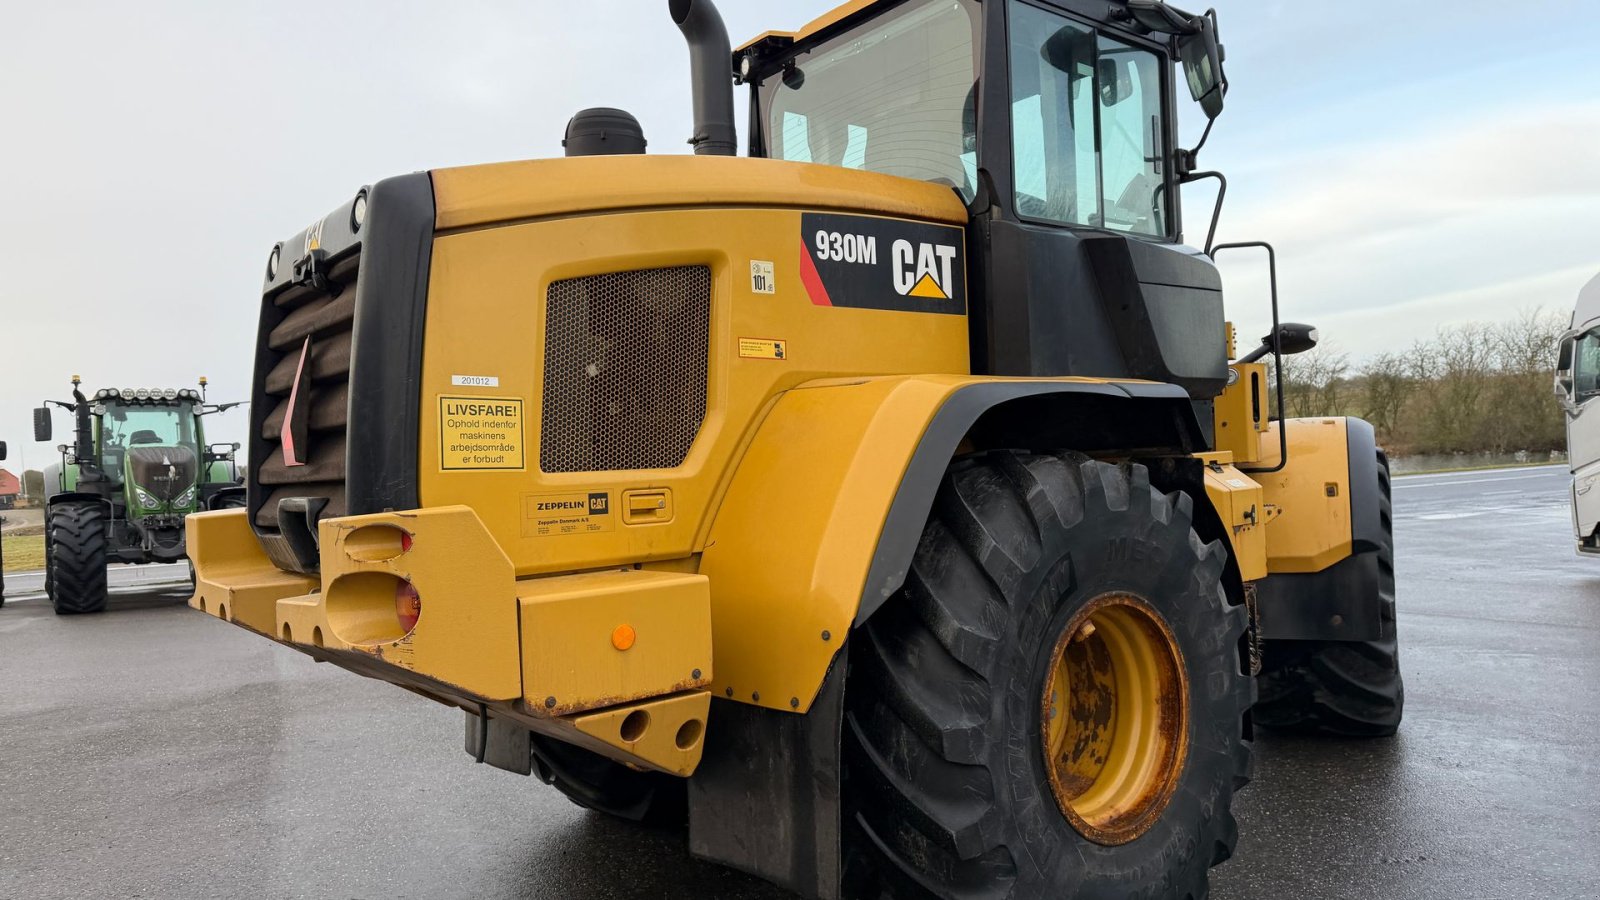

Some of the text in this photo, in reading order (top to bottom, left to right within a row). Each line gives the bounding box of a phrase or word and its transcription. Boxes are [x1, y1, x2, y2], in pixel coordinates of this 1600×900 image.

[815, 229, 877, 265] 930M
[892, 238, 956, 300] CAT
[752, 274, 766, 291] 101
[461, 376, 490, 386] 201012
[447, 403, 517, 417] LIVSFARE!
[447, 418, 517, 430] Ophold indenfor
[459, 431, 506, 440] maskinens
[450, 442, 515, 454] arbejdsområde
[473, 454, 505, 464] forbudt
[537, 497, 607, 511] ZEPPELIN CAT
